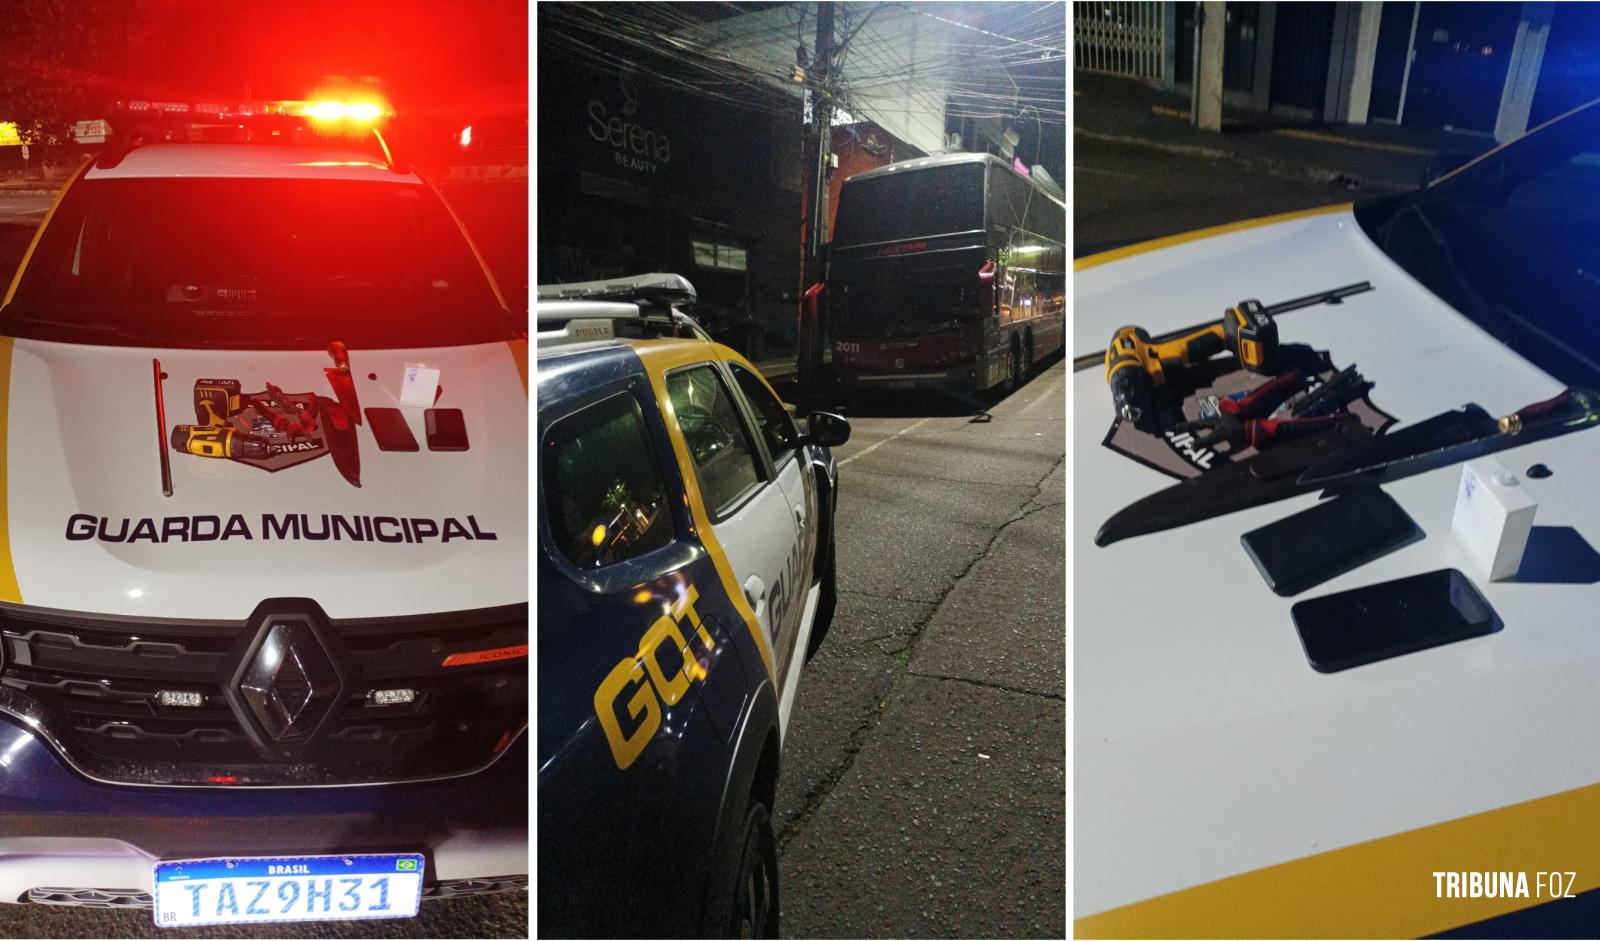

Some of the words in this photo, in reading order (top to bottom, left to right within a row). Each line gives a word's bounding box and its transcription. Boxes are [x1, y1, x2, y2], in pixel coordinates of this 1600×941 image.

[587, 100, 670, 162] Serena
[615, 151, 657, 173] BEAUTY
[836, 341, 861, 353] 2011
[65, 513, 253, 543] GUARDA
[261, 513, 498, 544] MUNICIPAL
[480, 649, 524, 660] ICONIC
[594, 583, 716, 770] GOT
[268, 864, 310, 875] BRASIL
[184, 877, 392, 918] TAZ9H31
[163, 911, 177, 922] BR
